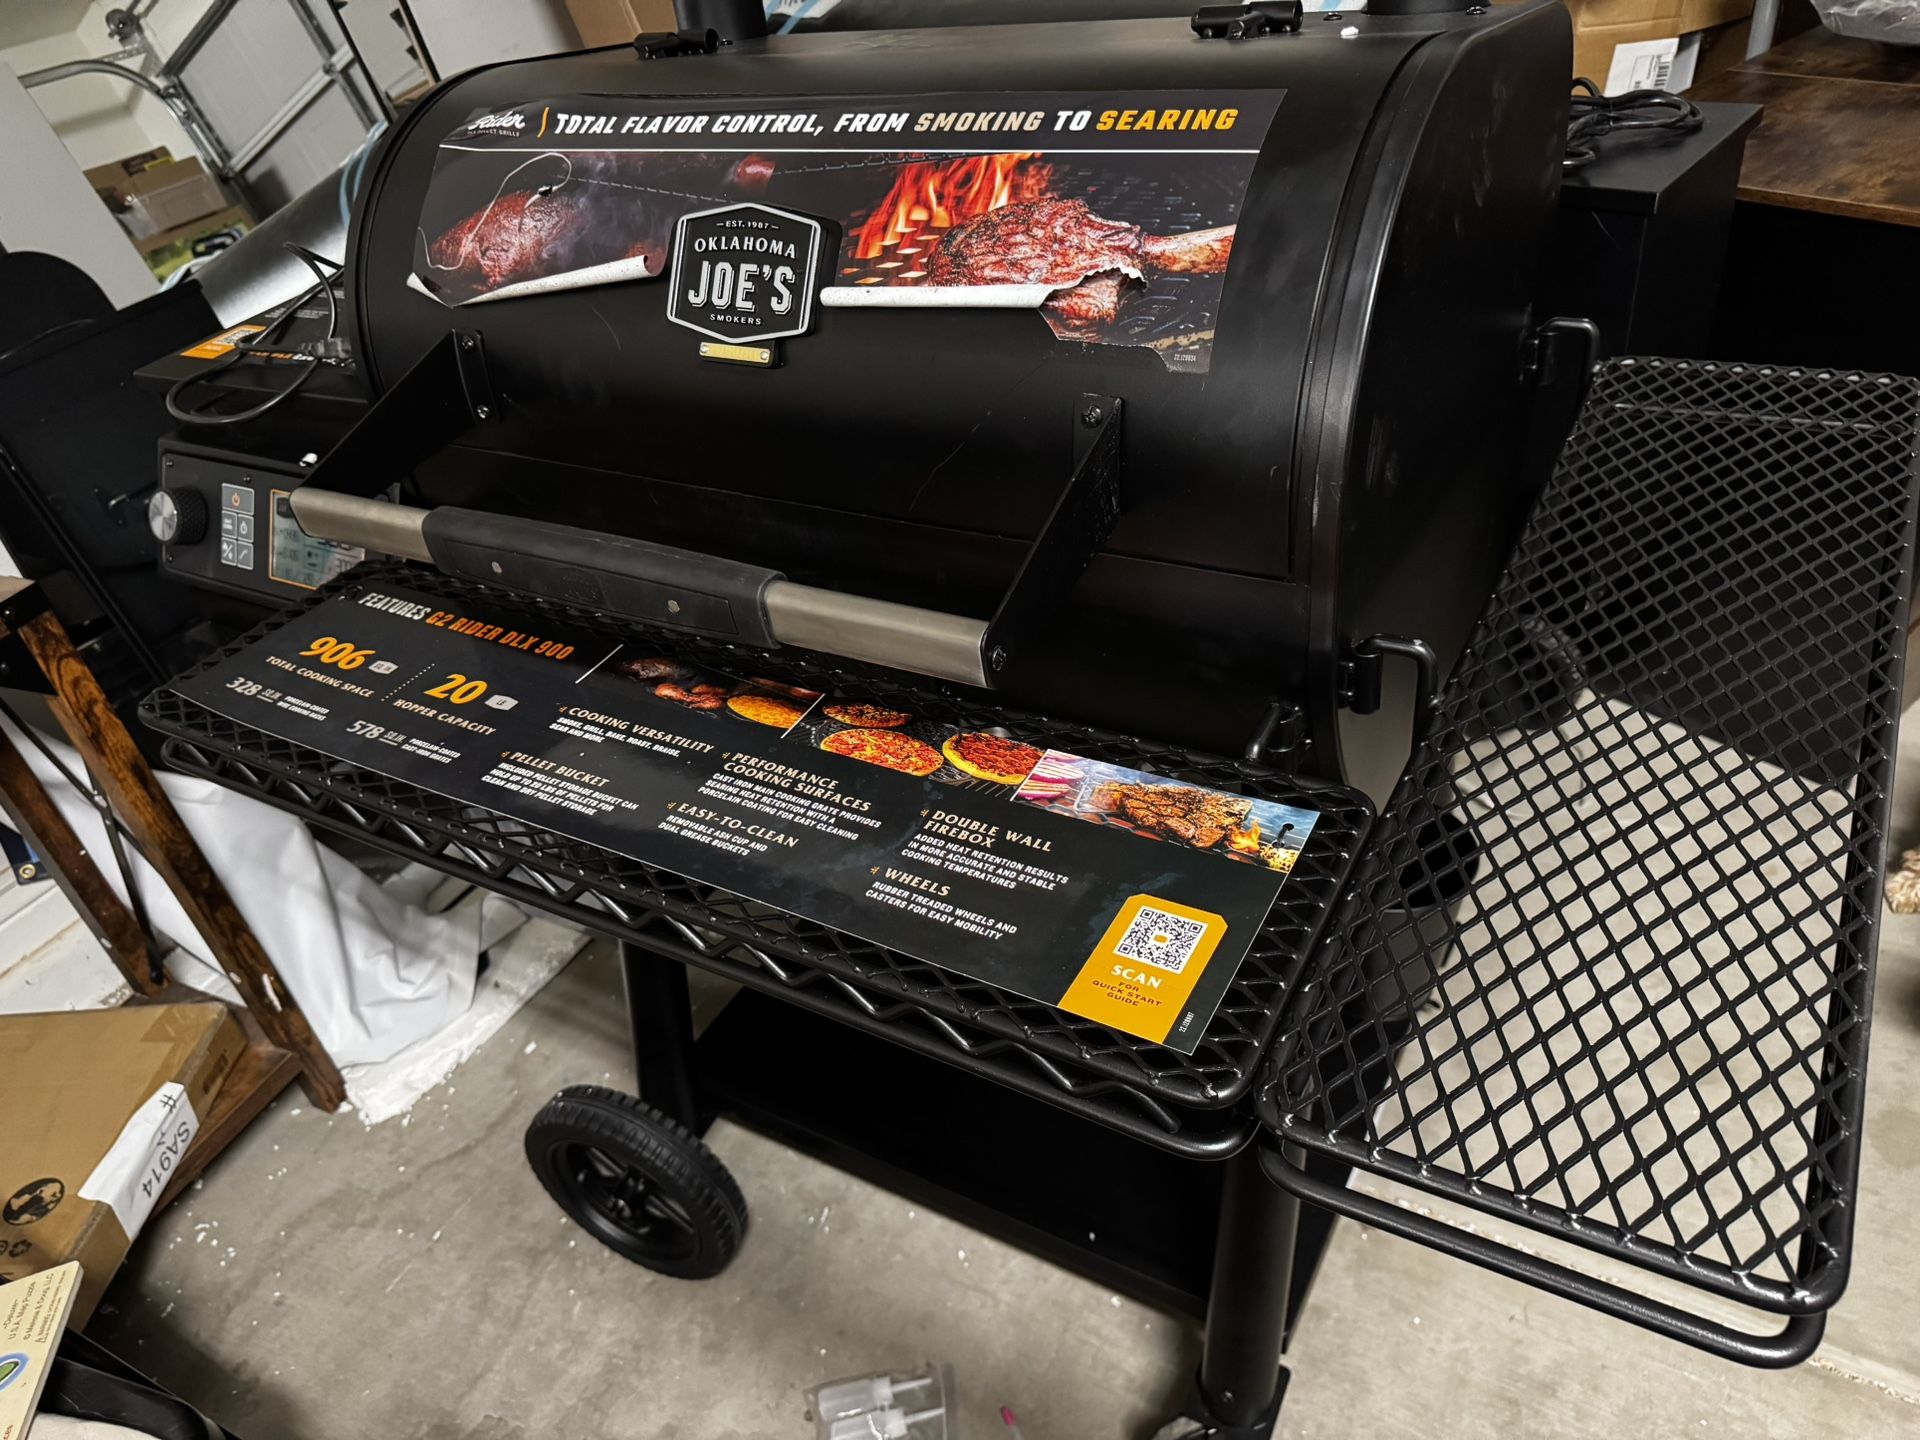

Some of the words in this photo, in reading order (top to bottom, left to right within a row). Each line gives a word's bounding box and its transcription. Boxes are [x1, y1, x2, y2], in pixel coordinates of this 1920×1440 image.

[467, 110, 526, 130] Rider
[555, 113, 617, 134] TOTAL
[621, 115, 715, 134] FLAVOR
[717, 113, 824, 136] CONTROL,
[833, 113, 908, 133] FROM
[914, 111, 1045, 132] SMOKING
[1053, 110, 1092, 131] TO
[1096, 108, 1239, 131] SEARING
[726, 220, 745, 228] EST.
[748, 221, 769, 229] 1987
[694, 236, 796, 259] OKLAHOMA
[688, 260, 796, 315] JOE'S
[710, 314, 762, 325] SMOKERS
[358, 592, 432, 620] FEATURES
[425, 611, 455, 627] G2
[448, 617, 504, 641] RIDER
[499, 628, 541, 650] DLX
[534, 640, 575, 660] 900
[298, 636, 377, 671] 906
[226, 676, 263, 696] 328
[266, 656, 296, 672] TOTAL
[297, 667, 343, 687] COOKING
[340, 683, 375, 698] SPACE
[424, 673, 488, 705] 20
[346, 720, 385, 739] 578
[393, 699, 438, 718] HOPPER
[437, 713, 497, 736] CAPACITY
[549, 722, 570, 733] SEAR
[567, 728, 585, 737] AND
[582, 732, 606, 743] MORE
[569, 707, 630, 730] COOKING
[632, 724, 715, 753] VERSATILITY
[605, 730, 627, 742] BAKE,
[626, 737, 652, 749] ROAST,
[652, 744, 681, 757] BRAISE,
[497, 762, 535, 777] INCLUDED
[531, 772, 561, 785] PELLET
[558, 781, 594, 796] STORAGE
[591, 791, 624, 805] BUCKET
[621, 800, 640, 811] CAN
[510, 751, 557, 770] PELLET
[555, 765, 610, 787] BUCKET
[723, 762, 793, 788] COOKING
[794, 782, 872, 811] SURFACES
[731, 752, 839, 789] PERFORMANCE
[481, 774, 507, 787] CLEAN
[503, 782, 522, 791] AND
[519, 786, 537, 796] DRY
[533, 791, 564, 805] PELLET
[561, 800, 598, 816] STORAGE
[489, 768, 512, 779] HOLD
[509, 774, 522, 782] UP
[520, 777, 533, 786] TO
[529, 781, 543, 789] 20
[539, 784, 557, 794] LBS
[565, 792, 600, 807] PELLETS
[596, 802, 615, 812] FOR
[705, 779, 740, 794] SEARING
[739, 790, 762, 800] HEAT
[760, 796, 806, 814] RETENTION
[806, 809, 830, 822] WITH
[712, 772, 735, 783] CAST
[733, 779, 754, 789] IRON
[753, 785, 776, 796] MAIN
[775, 791, 811, 807] COOKING
[811, 802, 840, 816] GRATE
[839, 810, 882, 828] PROVIDES
[677, 802, 800, 848] EASY-TO-CLEAN
[697, 786, 742, 804] PORCELAIN
[741, 799, 778, 815] COATING
[776, 811, 794, 820] FOR
[793, 815, 818, 827] EASY
[816, 822, 860, 841] CLEANING
[932, 810, 1000, 836] DOUBLE
[1005, 830, 1052, 852] WALL
[657, 822, 680, 834] DUAL
[680, 829, 713, 844] GREASE
[711, 839, 750, 856] BUCKETS
[666, 815, 715, 835] REMOVABLE
[713, 830, 733, 841] ASH
[731, 835, 750, 846] CUP
[748, 842, 769, 852] AND
[923, 820, 996, 848] FIREBOX
[901, 848, 943, 867] COOKING
[943, 861, 1017, 889] TEMPERATURES
[907, 840, 920, 849] IN
[919, 844, 947, 858] MORE
[946, 853, 996, 873] ACCURATE
[995, 867, 1017, 879] AND
[1017, 873, 1057, 891] STABLE
[914, 833, 946, 847] ADDED
[945, 842, 972, 855] HEAT
[970, 850, 1025, 871] RETENTION
[1024, 865, 1070, 884] RESULTS
[884, 867, 951, 897] WHEELS
[865, 889, 907, 909] CASTERS
[907, 903, 928, 916] FOR
[928, 911, 955, 925] EASY
[953, 919, 1003, 941] MOBILITY
[872, 881, 909, 898] RUBBER
[910, 893, 954, 913] TREADED
[954, 907, 996, 927] WHEELS
[994, 921, 1018, 934] AND
[1092, 980, 1124, 995] QUICK
[1127, 991, 1163, 1007] START
[1111, 964, 1163, 989] SCAN
[1118, 981, 1140, 993] FOR
[1107, 992, 1140, 1007] GUIDE
[141, 1121, 190, 1198] SA914
